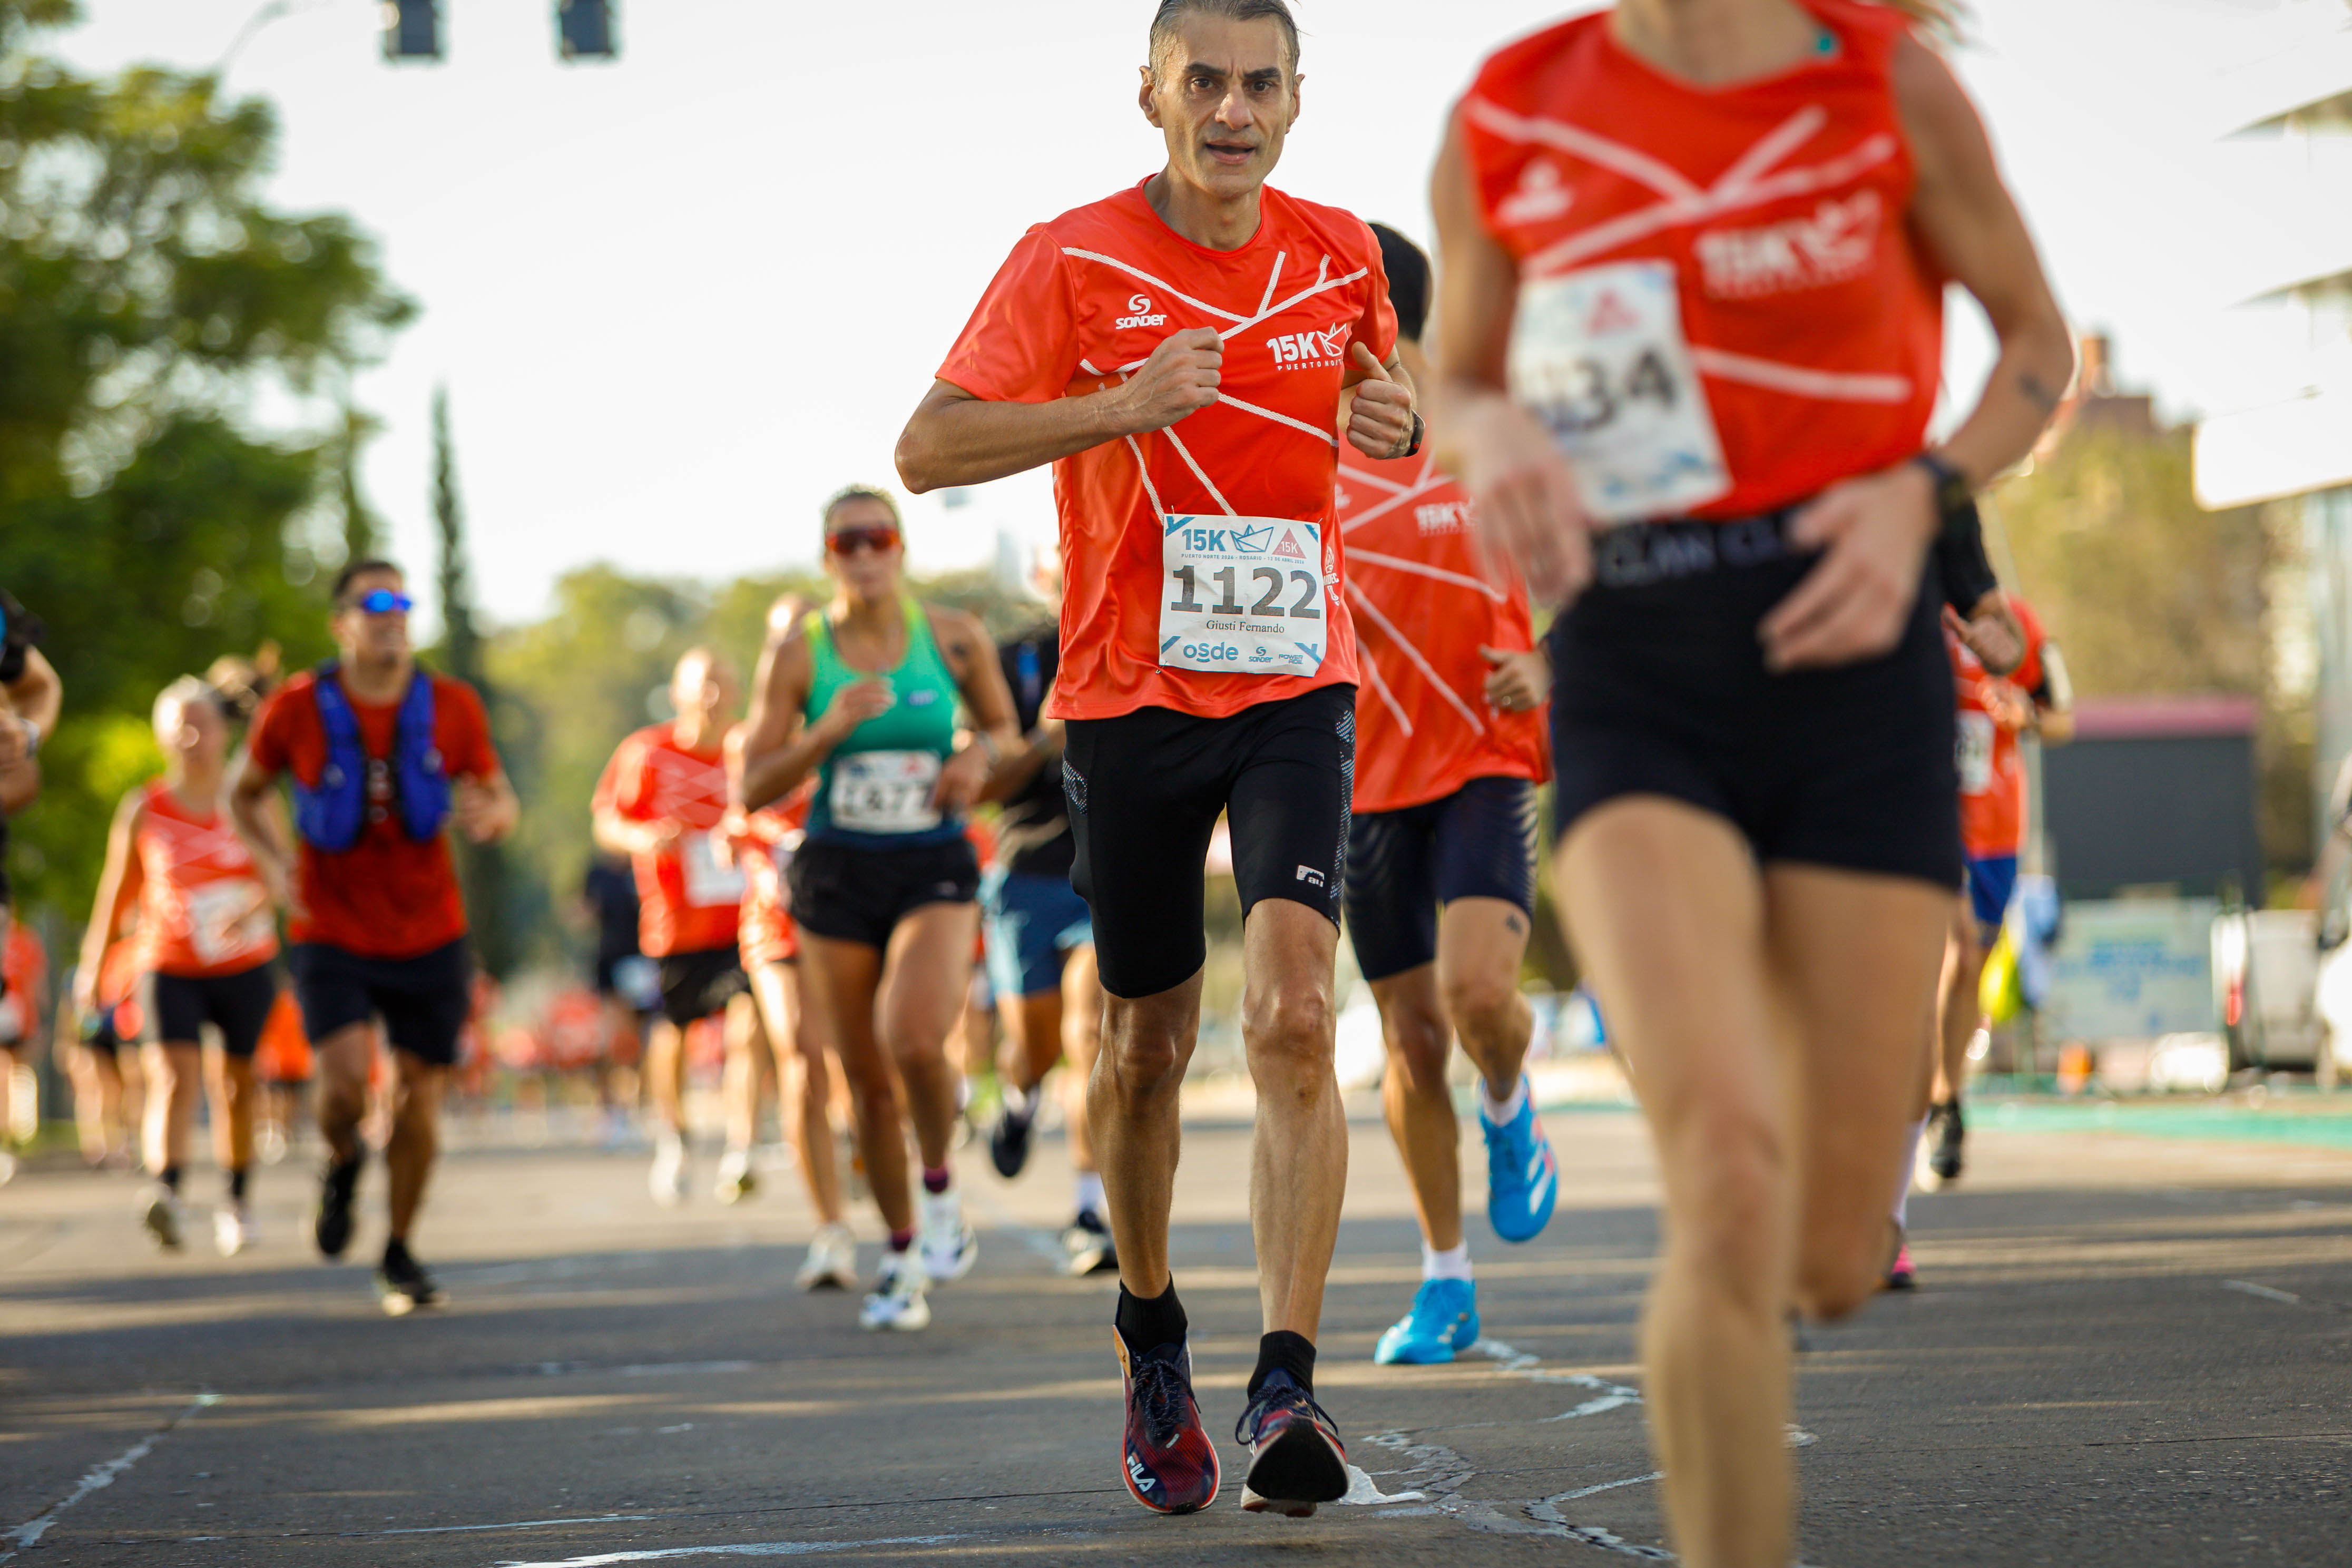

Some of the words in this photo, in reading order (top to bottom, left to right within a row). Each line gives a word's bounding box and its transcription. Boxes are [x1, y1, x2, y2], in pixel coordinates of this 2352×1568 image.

[1266, 331, 1320, 363] 15K
[1277, 361, 1321, 371] PUERTO
[1182, 528, 1226, 552] 15K
[1281, 541, 1299, 554] 15K
[1171, 565, 1320, 619] 1122
[1206, 620, 1236, 631] Giusti
[1239, 621, 1285, 633] Fernando
[1183, 641, 1239, 662] osde
[1127, 1452, 1156, 1492] FILA
